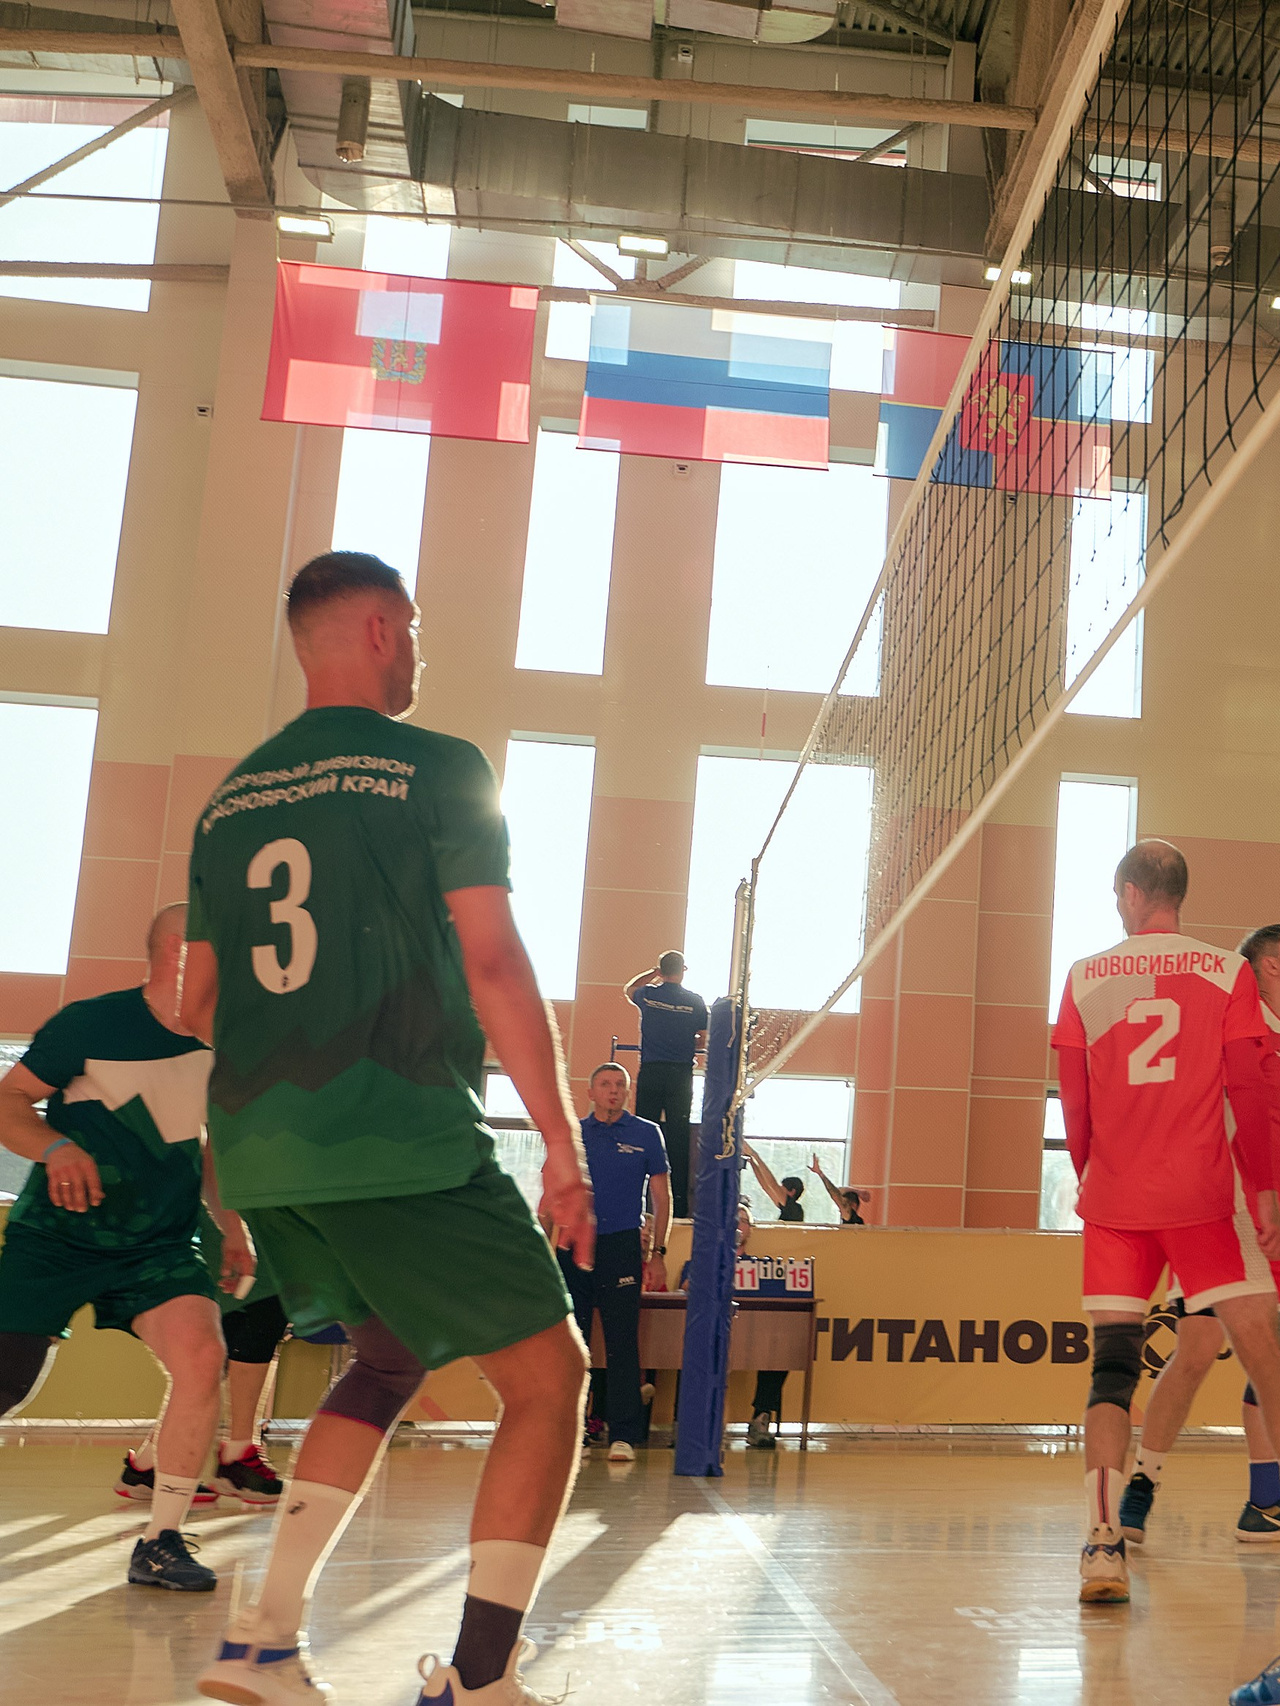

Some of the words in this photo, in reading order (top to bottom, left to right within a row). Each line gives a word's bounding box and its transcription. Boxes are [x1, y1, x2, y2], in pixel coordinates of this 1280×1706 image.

[341, 775, 410, 801] КРАЙ
[246, 837, 319, 995] 3
[1085, 951, 1228, 981] НОВОСИБИРСК
[1126, 998, 1181, 1086] 2
[735, 1267, 757, 1288] 11
[762, 1267, 768, 1278] 1
[775, 1267, 784, 1279] 0
[789, 1267, 810, 1289] 15
